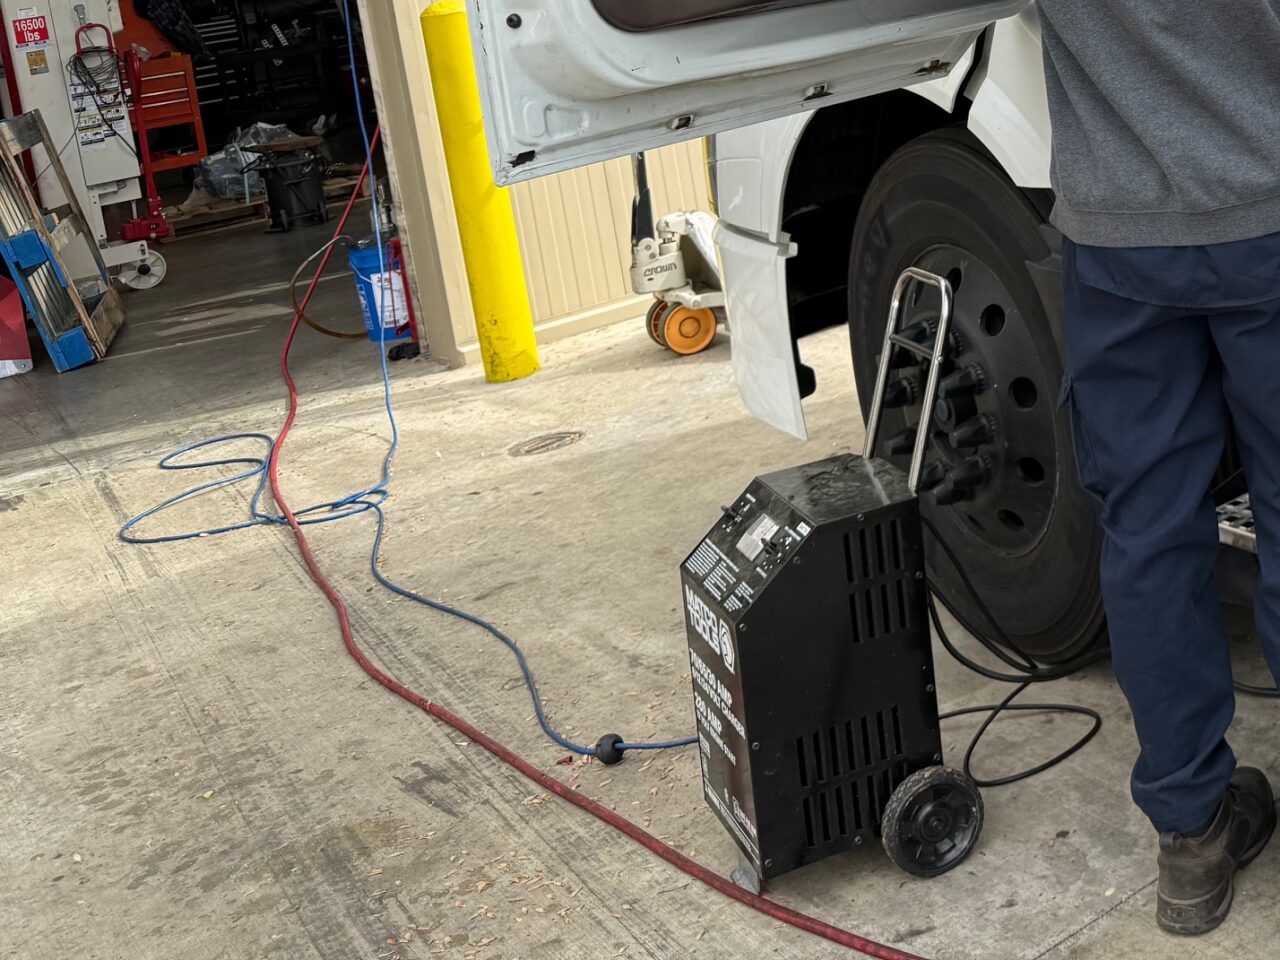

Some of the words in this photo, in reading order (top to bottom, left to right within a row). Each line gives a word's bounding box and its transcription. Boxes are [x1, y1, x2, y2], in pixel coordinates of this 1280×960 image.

[15, 17, 45, 32] 16500
[24, 30, 41, 42] lbs
[685, 584, 719, 636] MATCO
[687, 605, 720, 656] TOOLS
[717, 679, 733, 708] AMP
[707, 707, 722, 734] AMP
